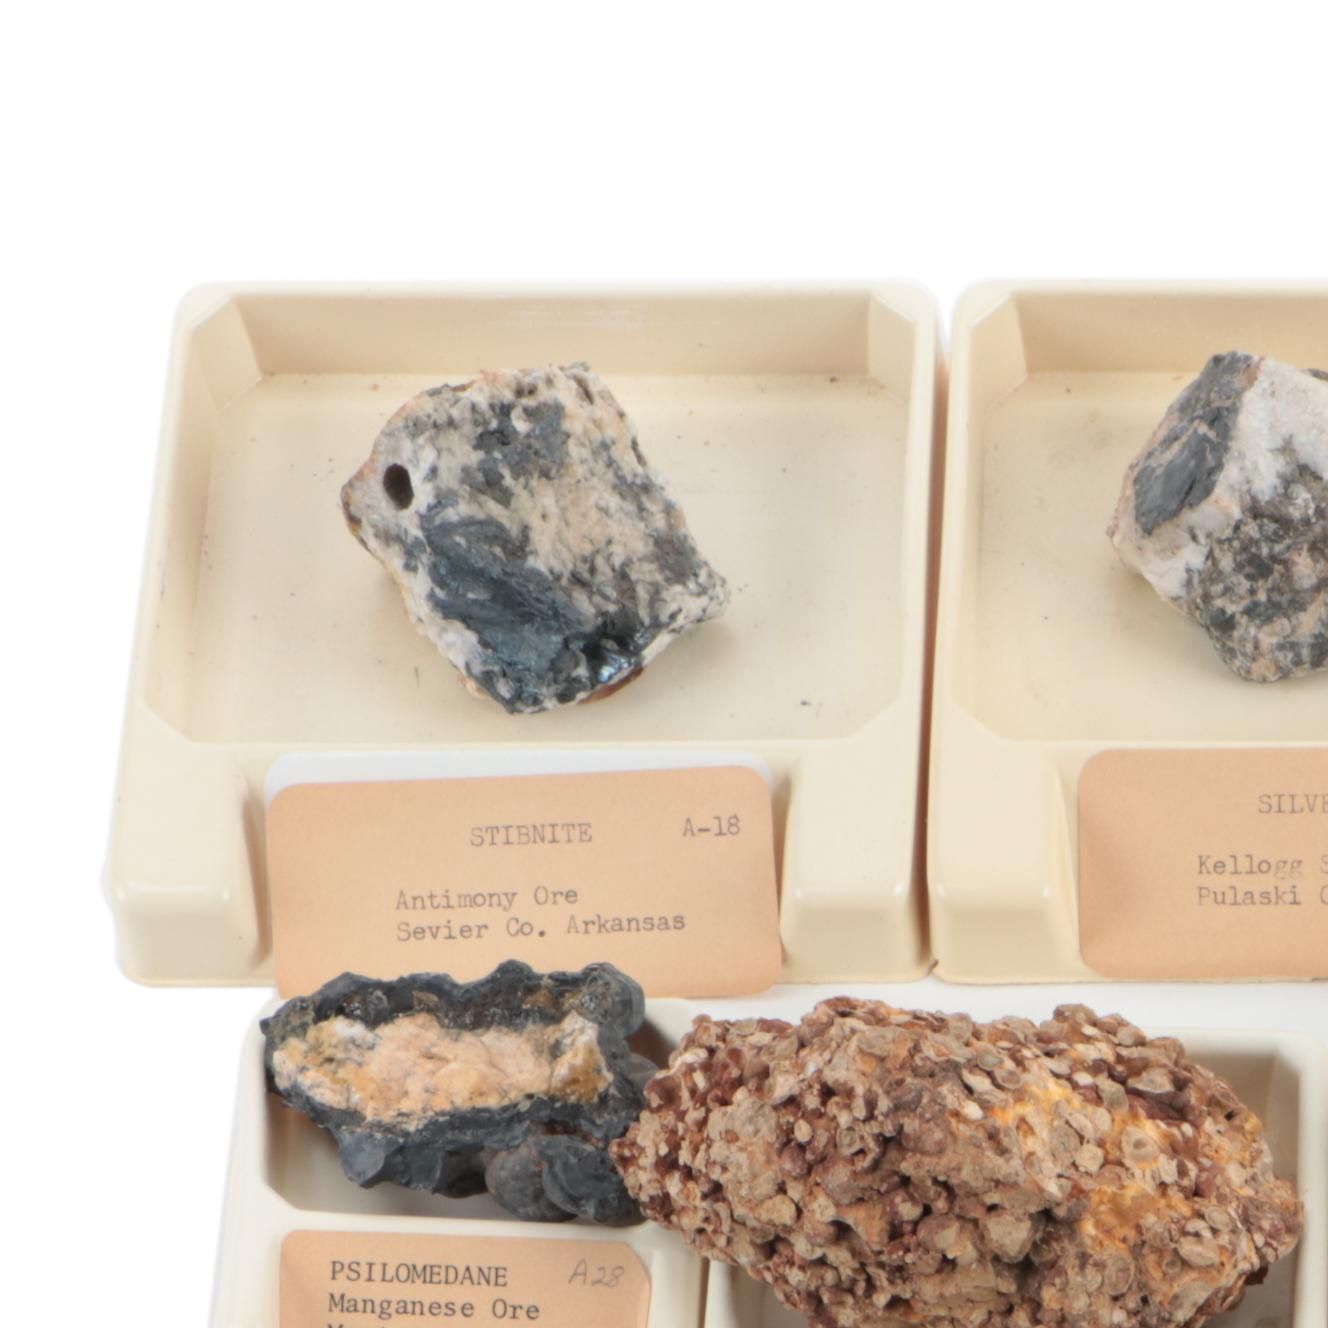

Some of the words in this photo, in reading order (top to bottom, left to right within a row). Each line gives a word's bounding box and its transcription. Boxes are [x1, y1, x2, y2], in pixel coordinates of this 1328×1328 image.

[470, 823, 593, 847] STIBNITE
[682, 815, 741, 838] A-18
[1197, 854, 1303, 880] Kellogg
[396, 888, 517, 912] Antimony
[534, 886, 579, 906] Ore
[1197, 886, 1302, 907] Pulaski
[397, 921, 488, 942] Sevier
[506, 918, 546, 938] Co.
[567, 913, 686, 936] Arkansas
[330, 1260, 509, 1288] PSILOMEDANE
[568, 1258, 626, 1288] A28
[328, 1293, 475, 1320] Manganese
[491, 1298, 541, 1320] Ore
